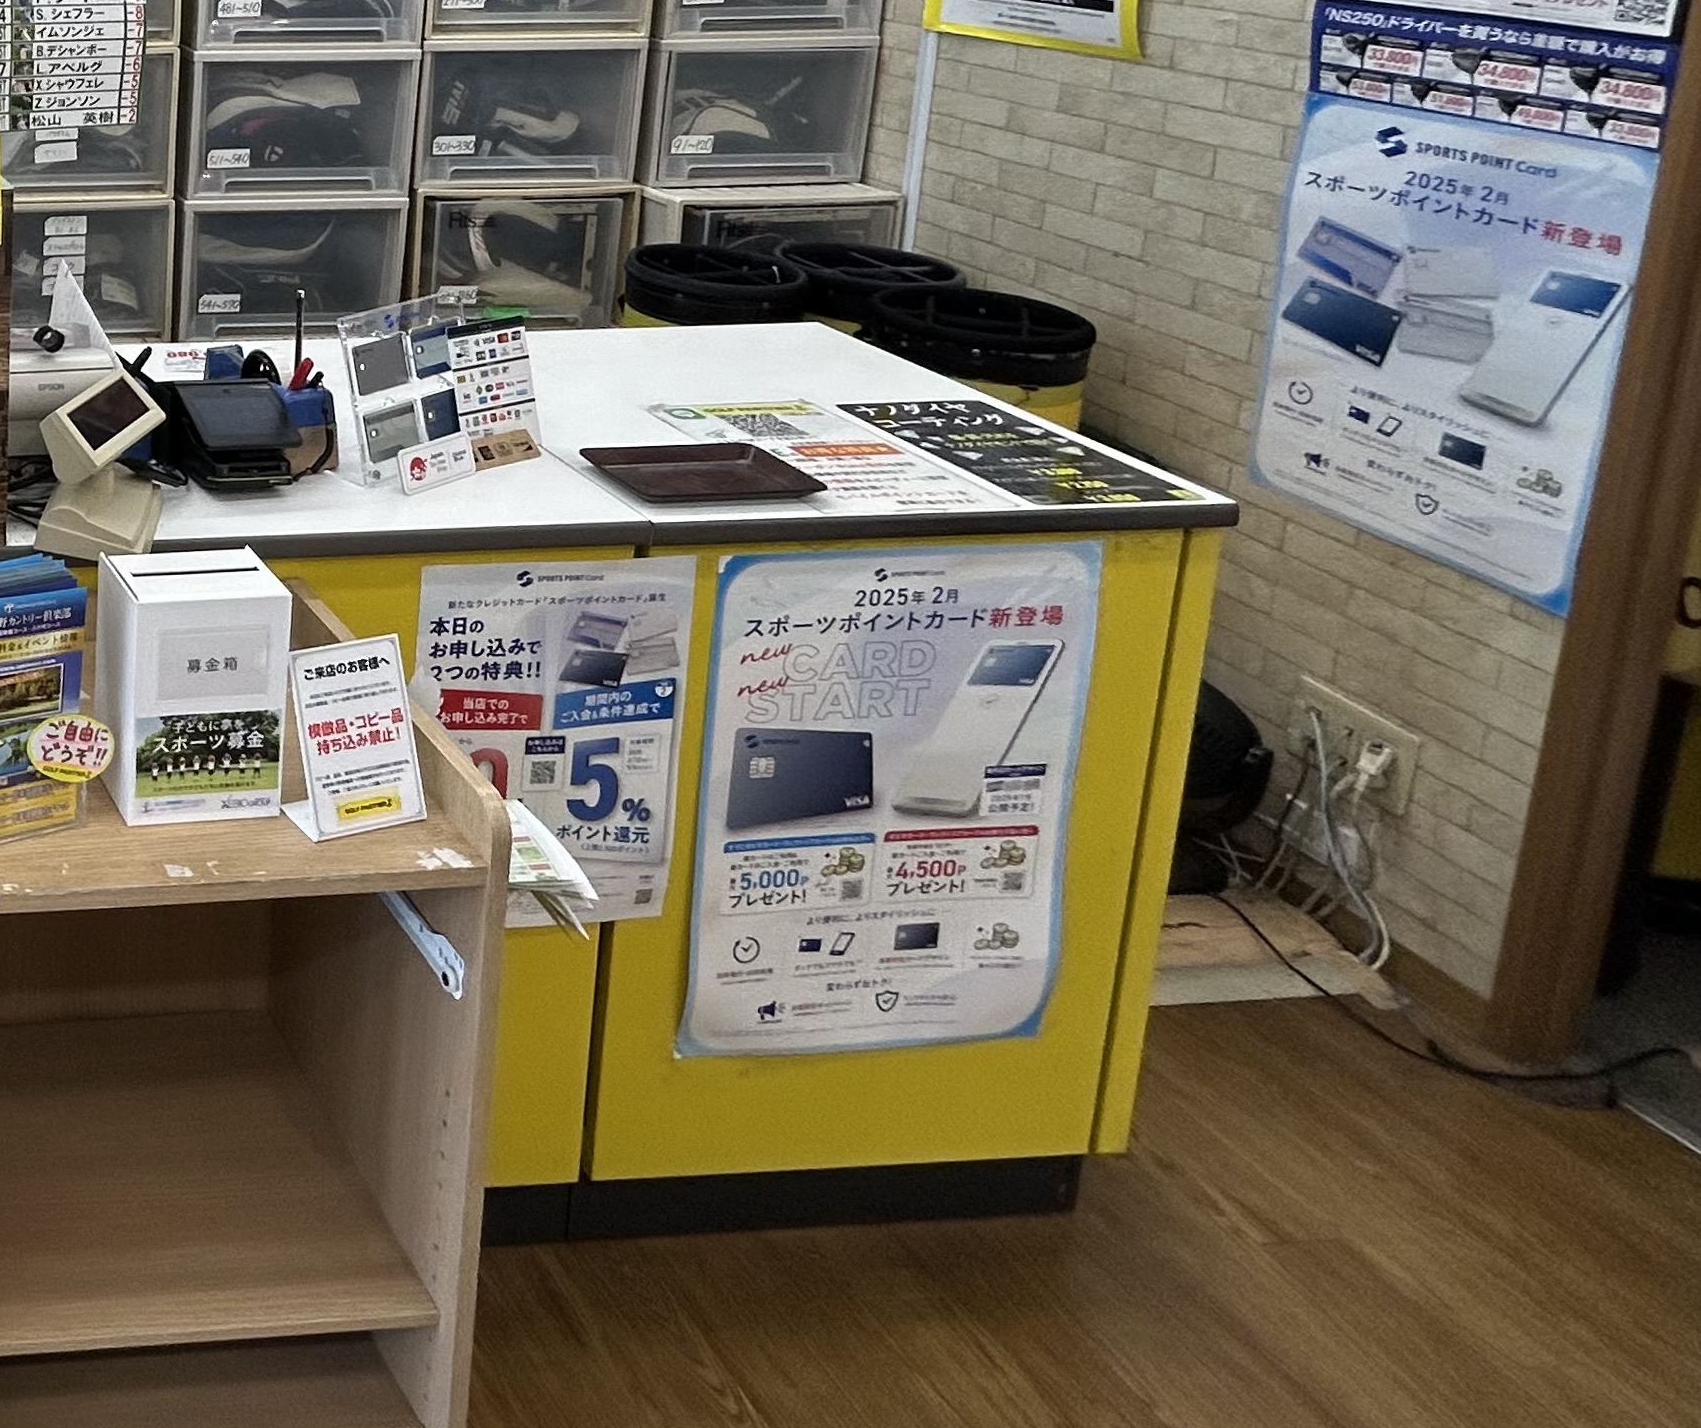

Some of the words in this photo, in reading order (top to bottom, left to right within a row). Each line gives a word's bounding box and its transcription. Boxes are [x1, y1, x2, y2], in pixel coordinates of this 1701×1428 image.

[0, 62, 6, 71] 7
[32, 115, 62, 127] 松山
[1415, 141, 1468, 163] SPORTS
[1471, 151, 1513, 171] POINT
[1515, 159, 1558, 179] Card
[1404, 171, 1475, 197] 2025年
[1304, 171, 1623, 257] スポーツポイントカード新登場
[854, 587, 926, 608] 2025年
[932, 586, 960, 605] 2月
[429, 616, 485, 637] 本日の
[743, 605, 1065, 638] スポーツポイントカード新登場
[429, 638, 543, 659] お申し込みで
[187, 656, 238, 673] 募金箱
[303, 656, 391, 681] ご来店のお客様へ
[740, 642, 793, 665] new
[782, 639, 938, 683] CARD
[737, 675, 790, 698] new
[462, 697, 509, 711] 当店での
[584, 690, 632, 707] 期間内の
[745, 679, 931, 724] START
[307, 707, 404, 739] 模倣品・コピー品
[440, 711, 529, 725] お申し込み完了で
[46, 721, 109, 742] ご自由に
[152, 730, 265, 753] スポーツ募金
[316, 728, 401, 756] 持ち込み禁止！
[556, 824, 650, 844] ポイント還元
[886, 878, 965, 897] プレゼント！
[728, 888, 807, 909] プレゼント！
